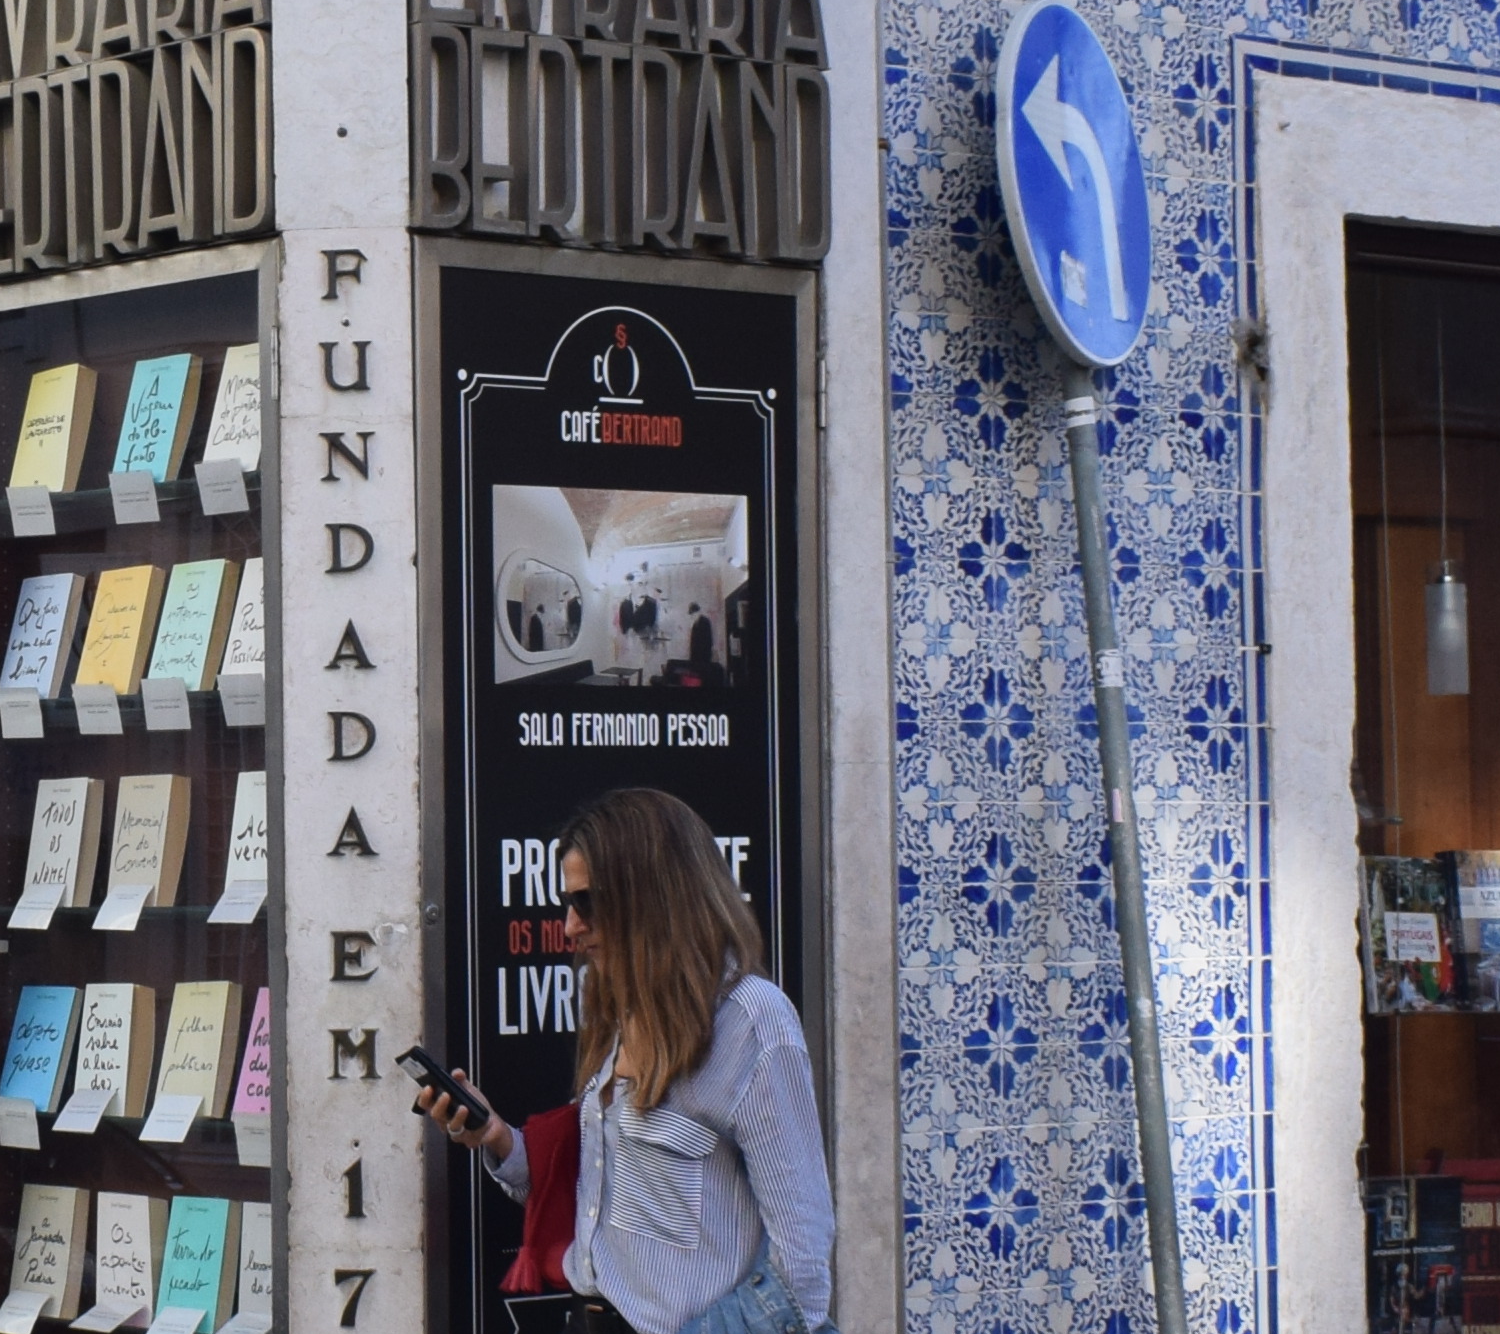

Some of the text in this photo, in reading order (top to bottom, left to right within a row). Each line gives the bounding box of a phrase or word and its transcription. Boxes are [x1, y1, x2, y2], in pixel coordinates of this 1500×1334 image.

[409, 23, 832, 262] BERTRAND
[319, 248, 379, 857] FUNDADA
[518, 712, 730, 747] SALA FERNANDO PESSOA
[329, 930, 381, 1081] EM
[508, 920, 533, 955] OS
